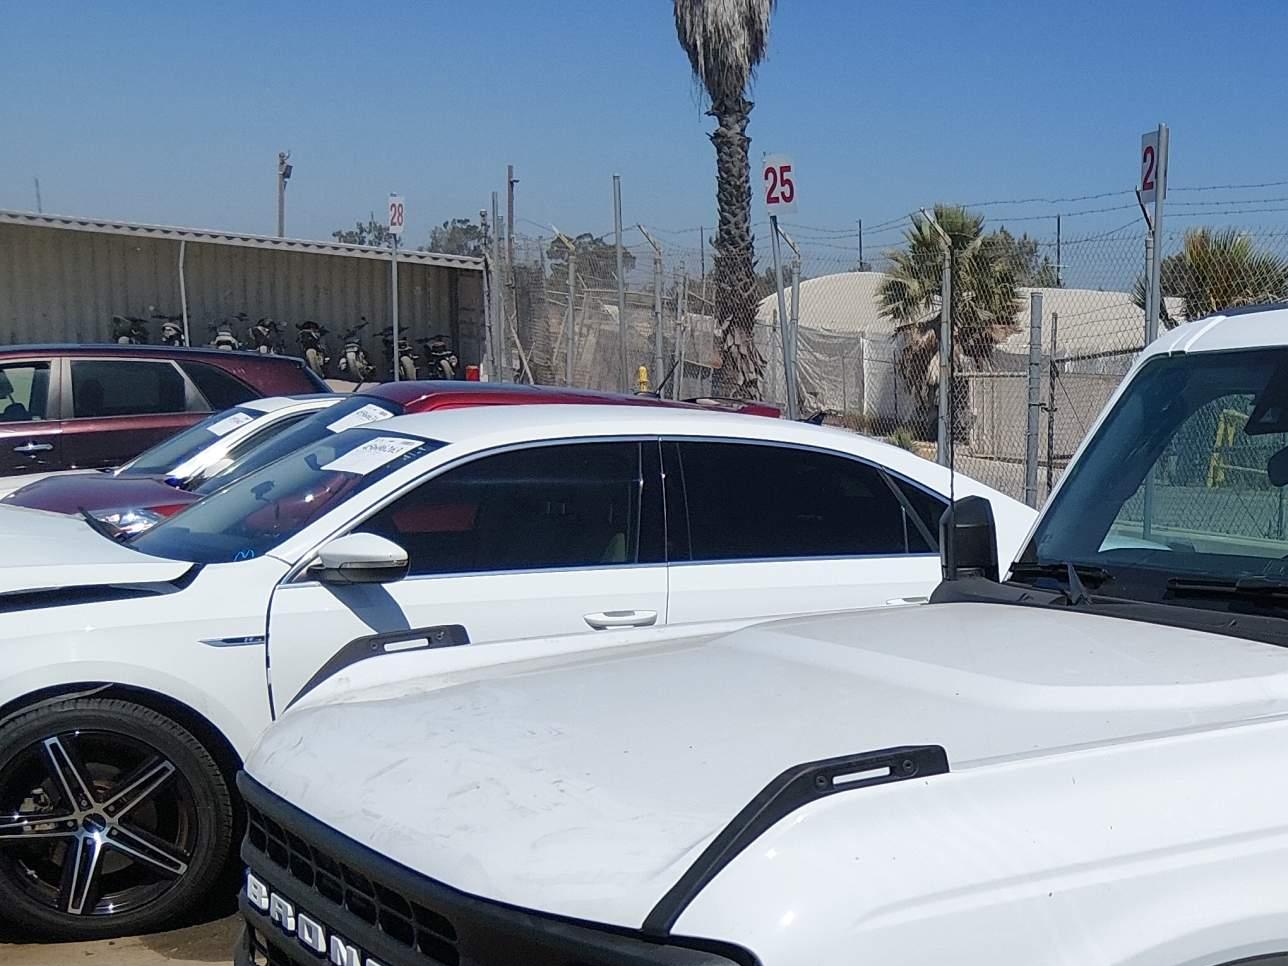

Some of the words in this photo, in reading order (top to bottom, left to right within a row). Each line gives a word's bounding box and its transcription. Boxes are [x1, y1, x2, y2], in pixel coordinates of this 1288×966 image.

[764, 165, 794, 204] 25
[1143, 145, 1156, 191] 2
[390, 203, 403, 226] 28
